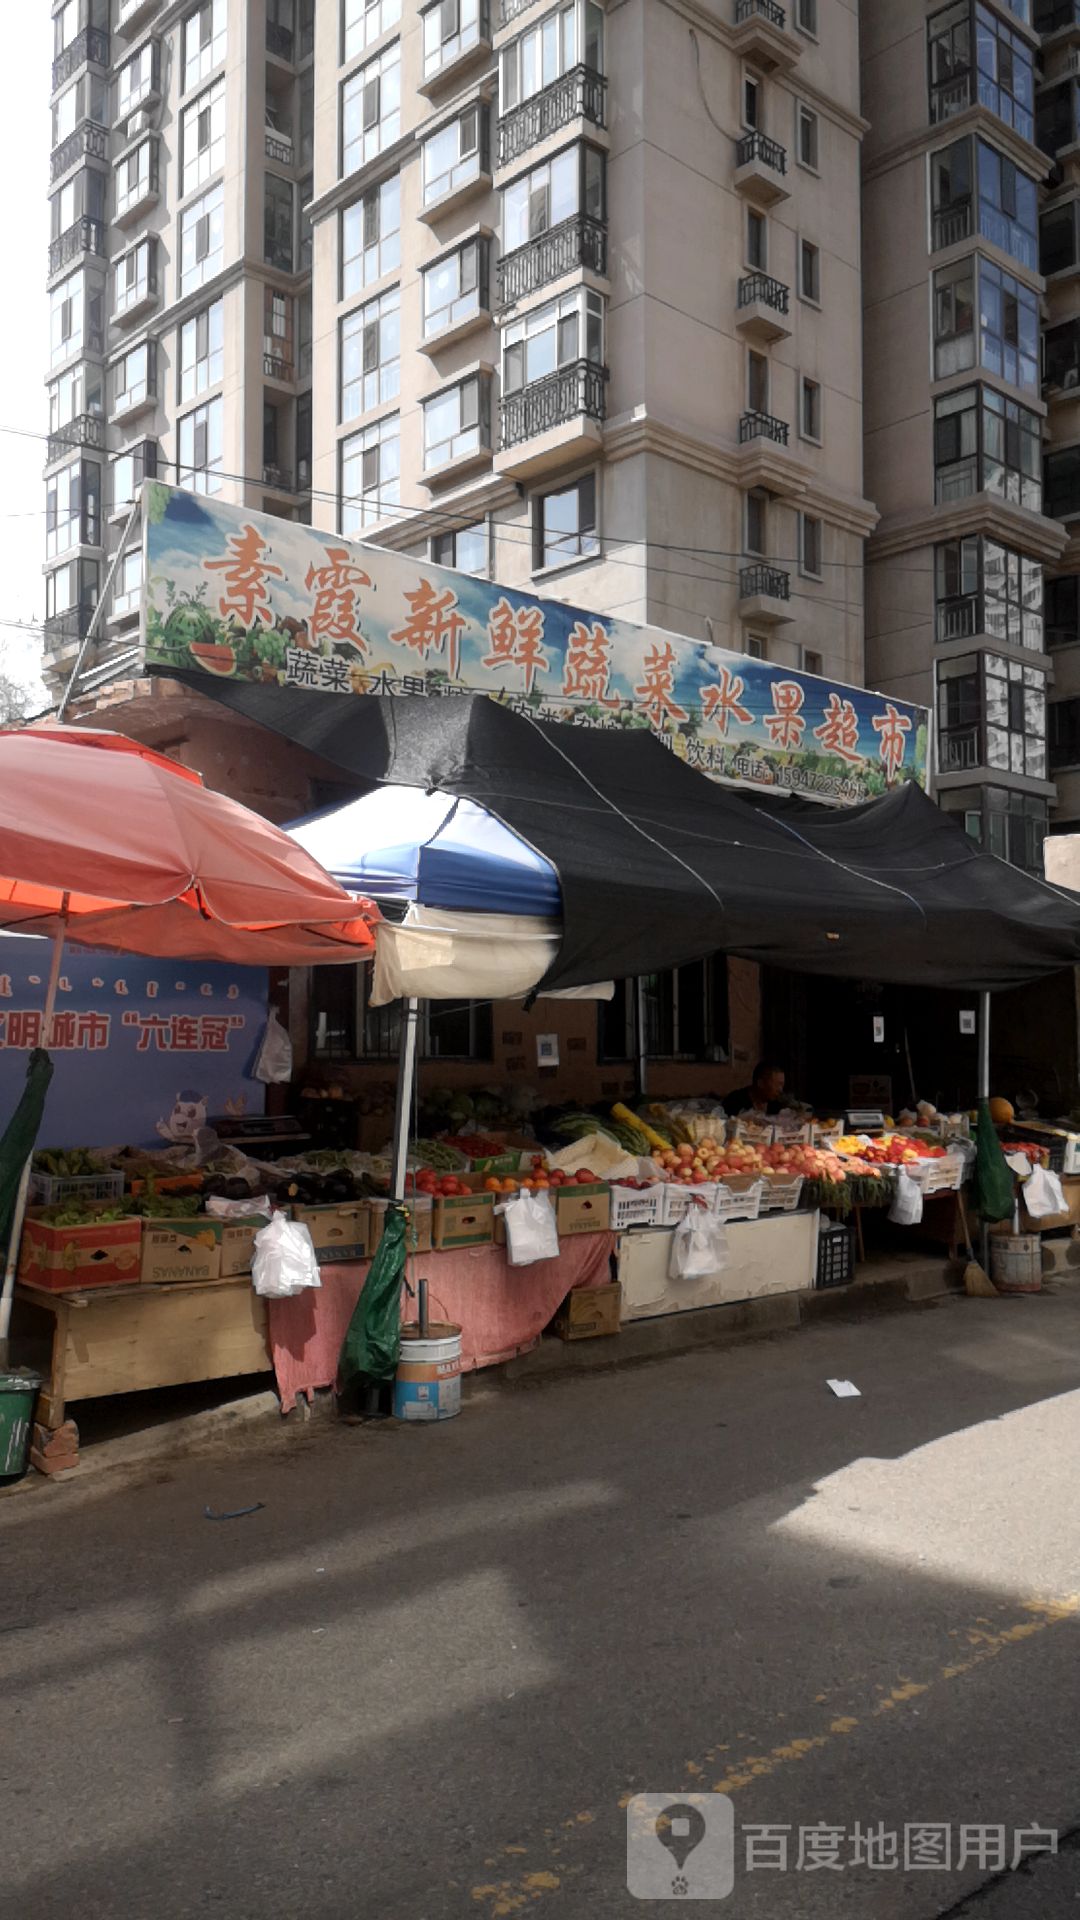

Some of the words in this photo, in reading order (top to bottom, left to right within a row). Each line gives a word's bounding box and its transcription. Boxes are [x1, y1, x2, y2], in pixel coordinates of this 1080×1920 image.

[204, 524, 912, 782] 素霞新鲜蔬菜水果超市
[289, 650, 350, 692] 蔬菜
[686, 737, 725, 770] 饮料
